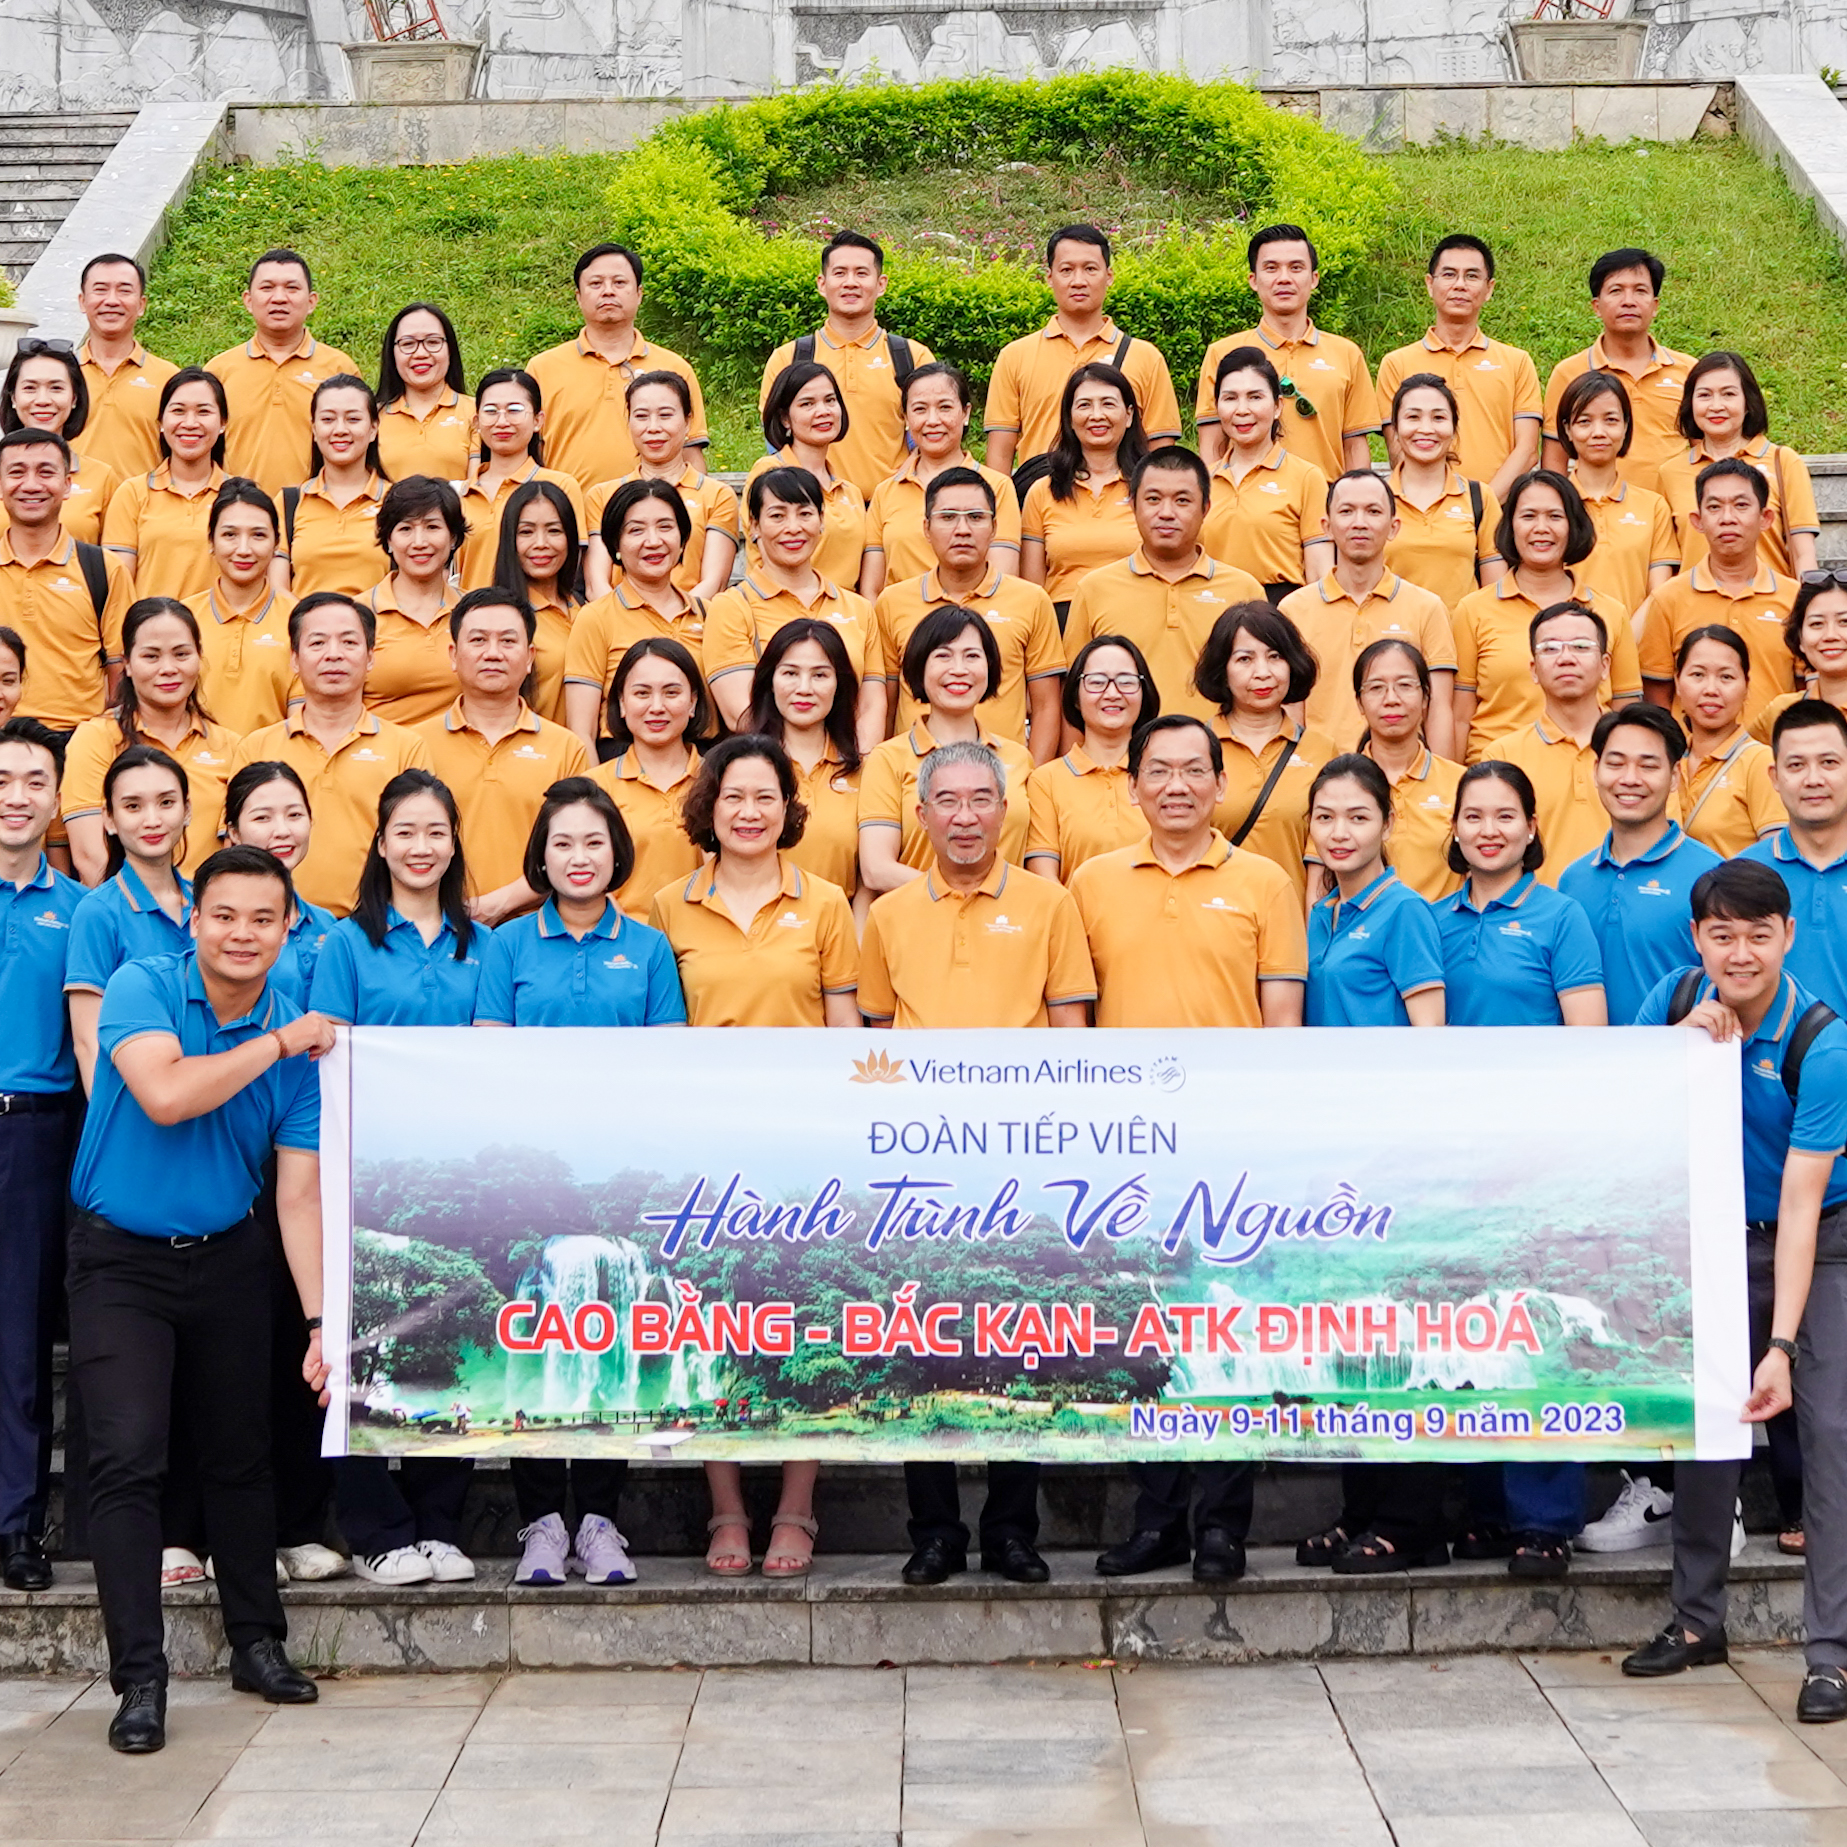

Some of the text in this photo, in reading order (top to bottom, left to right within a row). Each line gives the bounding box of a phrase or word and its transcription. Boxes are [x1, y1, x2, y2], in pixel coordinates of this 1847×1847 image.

[910, 1058, 1142, 1084] Vietnam Airlines
[868, 1111, 1177, 1154] ĐOÀN TIẾP VIÊN
[645, 1171, 1393, 1263] Hành Trình Về Nguồn
[498, 1303, 616, 1352] CAO
[632, 1280, 794, 1353] BẰNG
[806, 1327, 830, 1341] -
[844, 1281, 961, 1352] BẮC
[1126, 1305, 1243, 1353] ATK
[1255, 1304, 1396, 1366] ĐỊNH
[1416, 1292, 1543, 1353] HOÁ
[1131, 1405, 1625, 1440] Ngày 9-11 tháng 9 năm 2023
